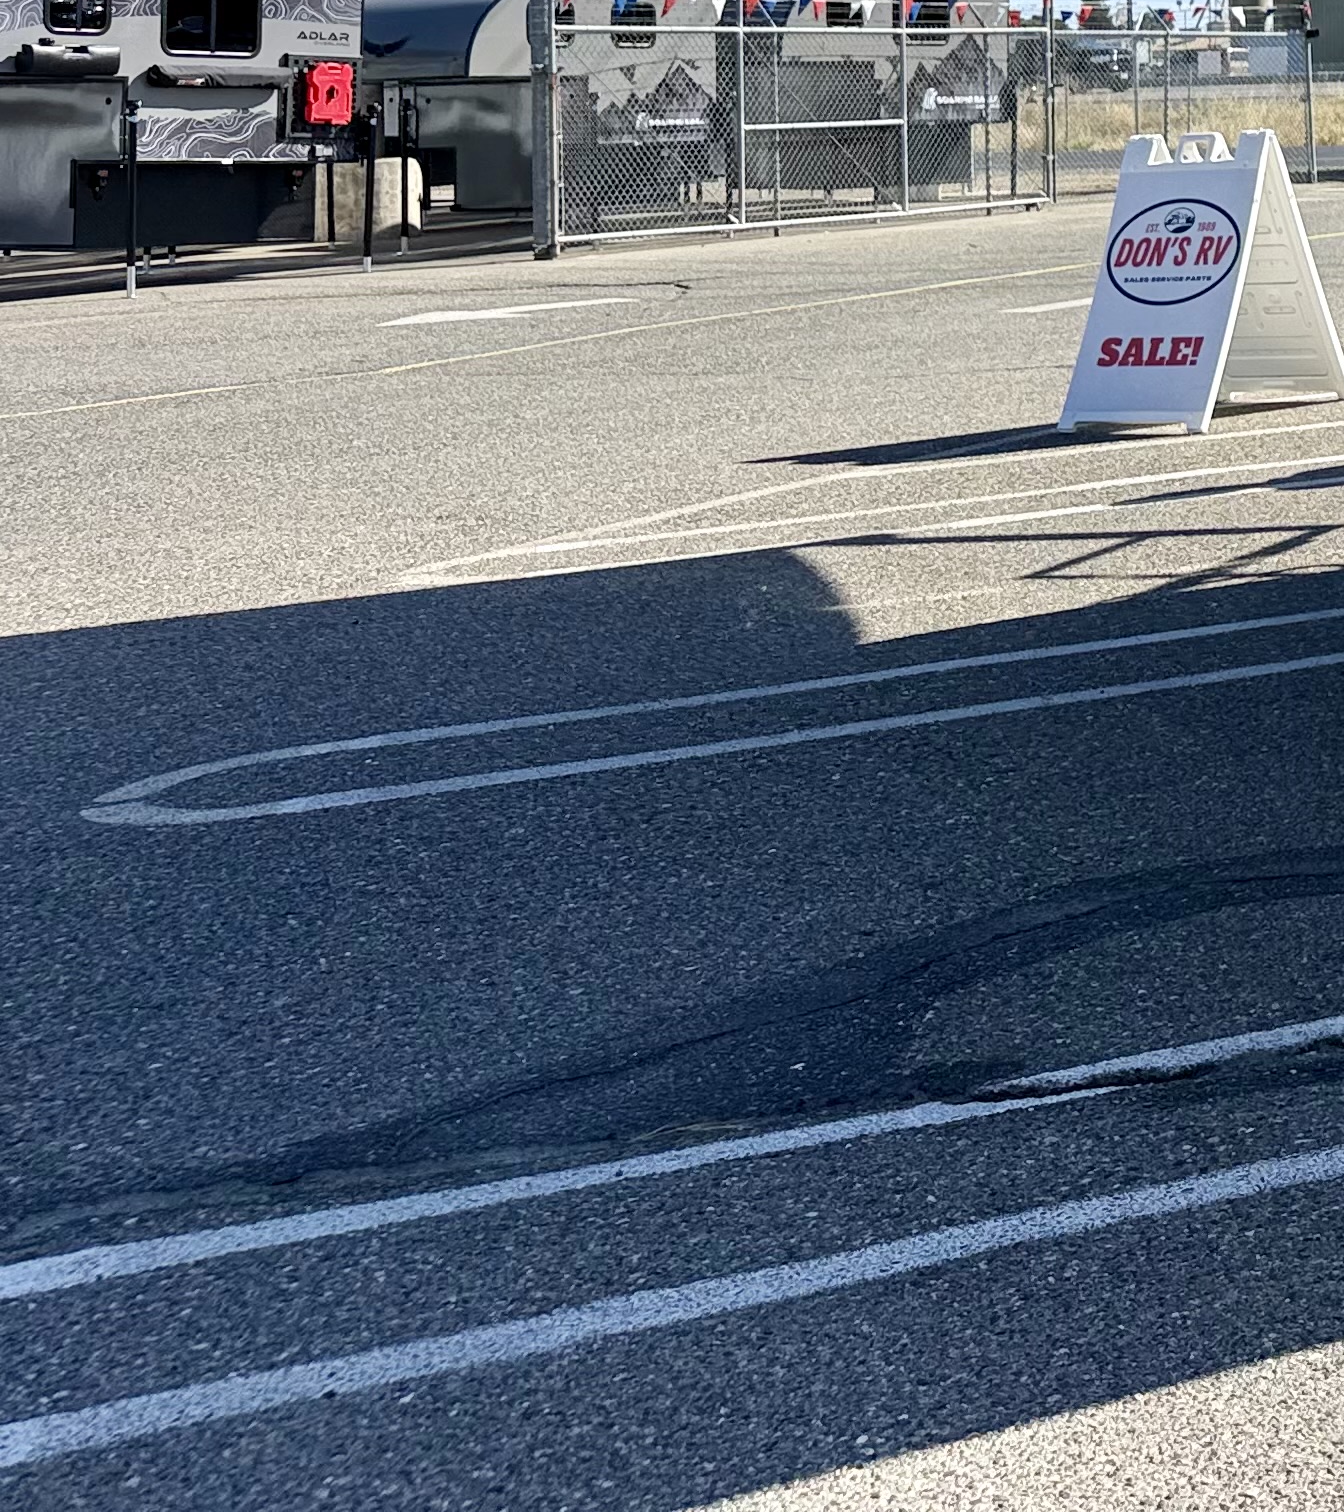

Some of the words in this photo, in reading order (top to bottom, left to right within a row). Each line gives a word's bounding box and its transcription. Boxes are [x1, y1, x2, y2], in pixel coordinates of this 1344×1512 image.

[296, 30, 349, 42] ADLAR
[1114, 236, 1192, 268] DON'S
[1194, 235, 1234, 266] RV
[1096, 336, 1205, 367] SALE!
